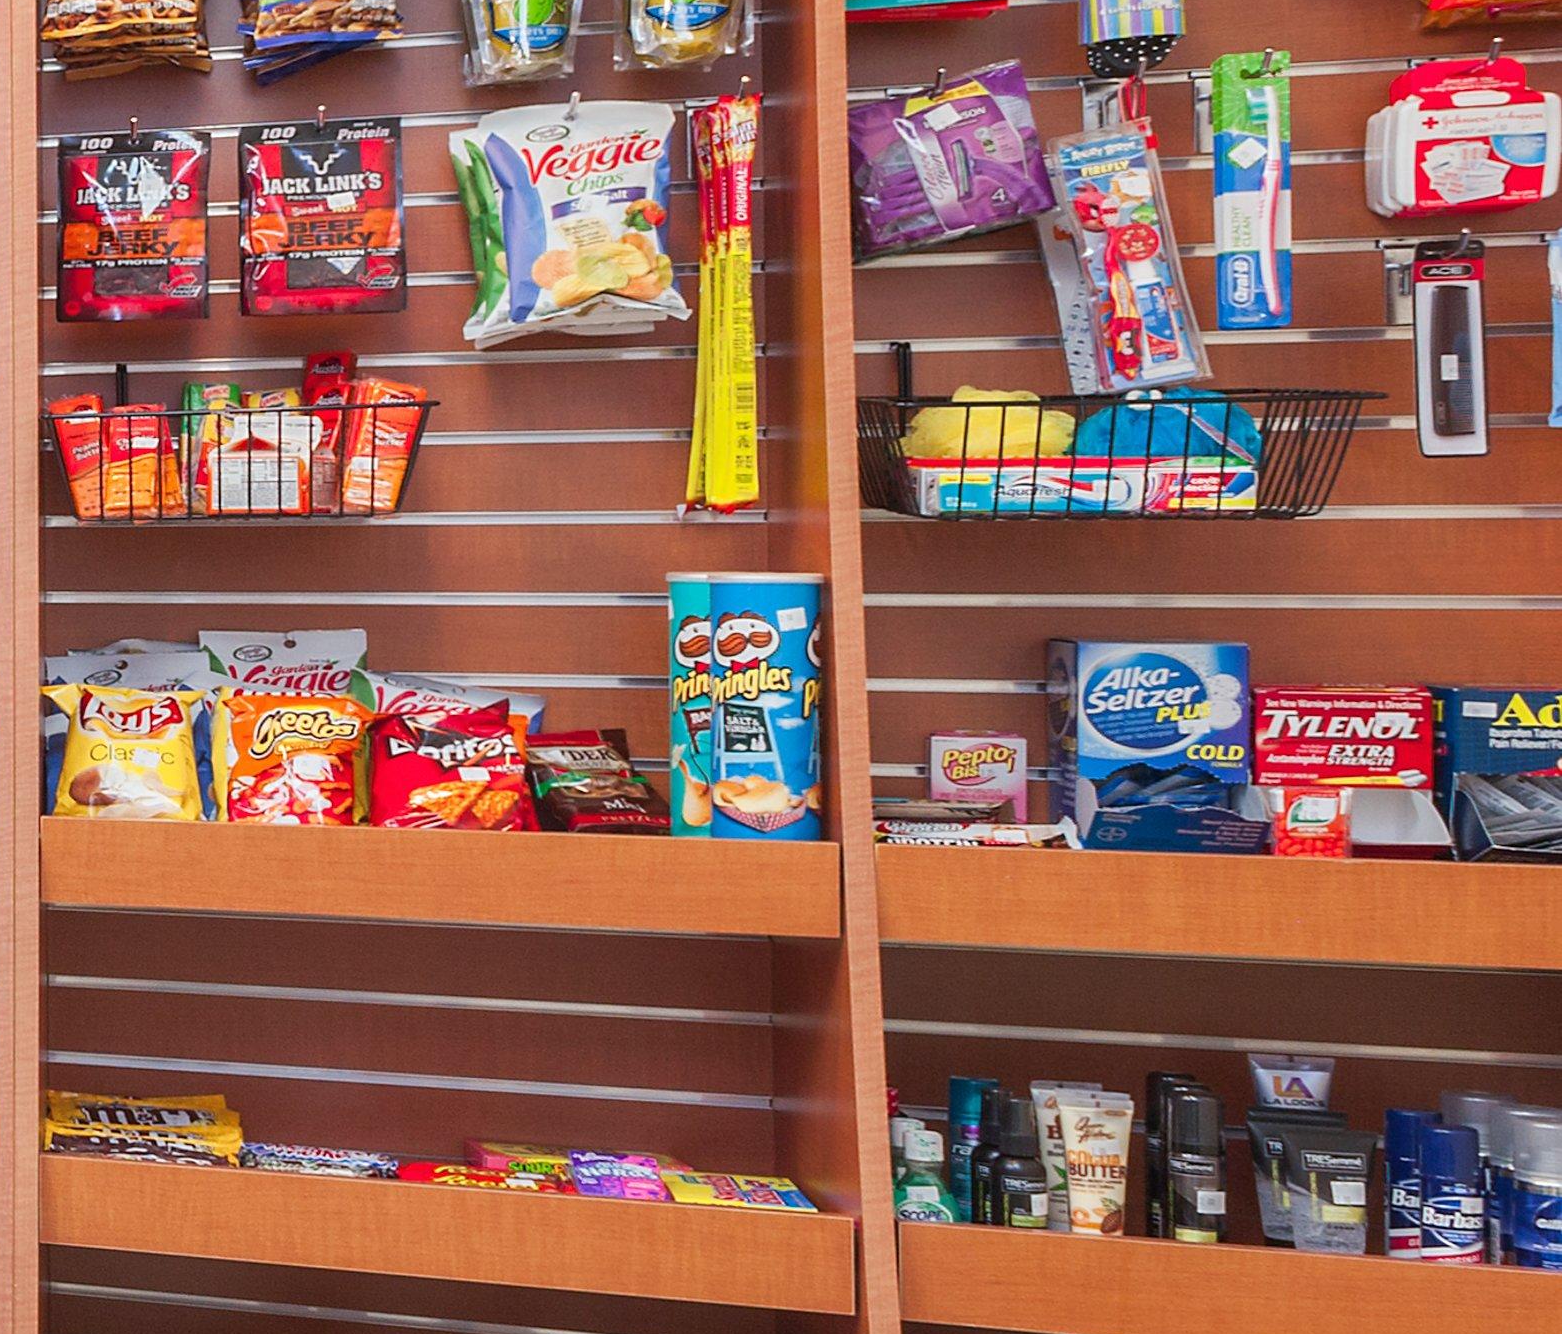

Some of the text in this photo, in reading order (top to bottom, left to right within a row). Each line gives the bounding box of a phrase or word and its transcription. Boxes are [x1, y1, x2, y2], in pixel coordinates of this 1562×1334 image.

[261, 126, 390, 141] 100 Protein
[80, 138, 114, 151] 100
[521, 135, 662, 185] Veggie
[1081, 160, 1130, 178] FIREFLY
[264, 171, 383, 195] JACK LINK'S
[567, 173, 624, 196] Chips
[76, 185, 122, 204] JACK
[735, 168, 749, 221] ORIGINAL
[292, 218, 364, 233] BEEF
[98, 228, 168, 243] BEEF
[280, 231, 376, 249] JERKY
[87, 242, 179, 256] JERKY
[313, 248, 365, 257] PROTEIN
[1427, 263, 1461, 278] ACE
[1228, 256, 1253, 306] Oral-B
[1093, 666, 1180, 692] Alka-
[673, 669, 710, 712] Prin
[1085, 683, 1201, 715] Seltzer
[1265, 699, 1423, 710] See New Warnings Information Directions
[80, 692, 182, 736] Lay's
[250, 705, 360, 760] Cheetos
[1261, 709, 1421, 741] TYLENOL
[1185, 743, 1245, 761] COLD
[1328, 744, 1395, 759] EXTRA
[1326, 757, 1394, 767] STRENGTH
